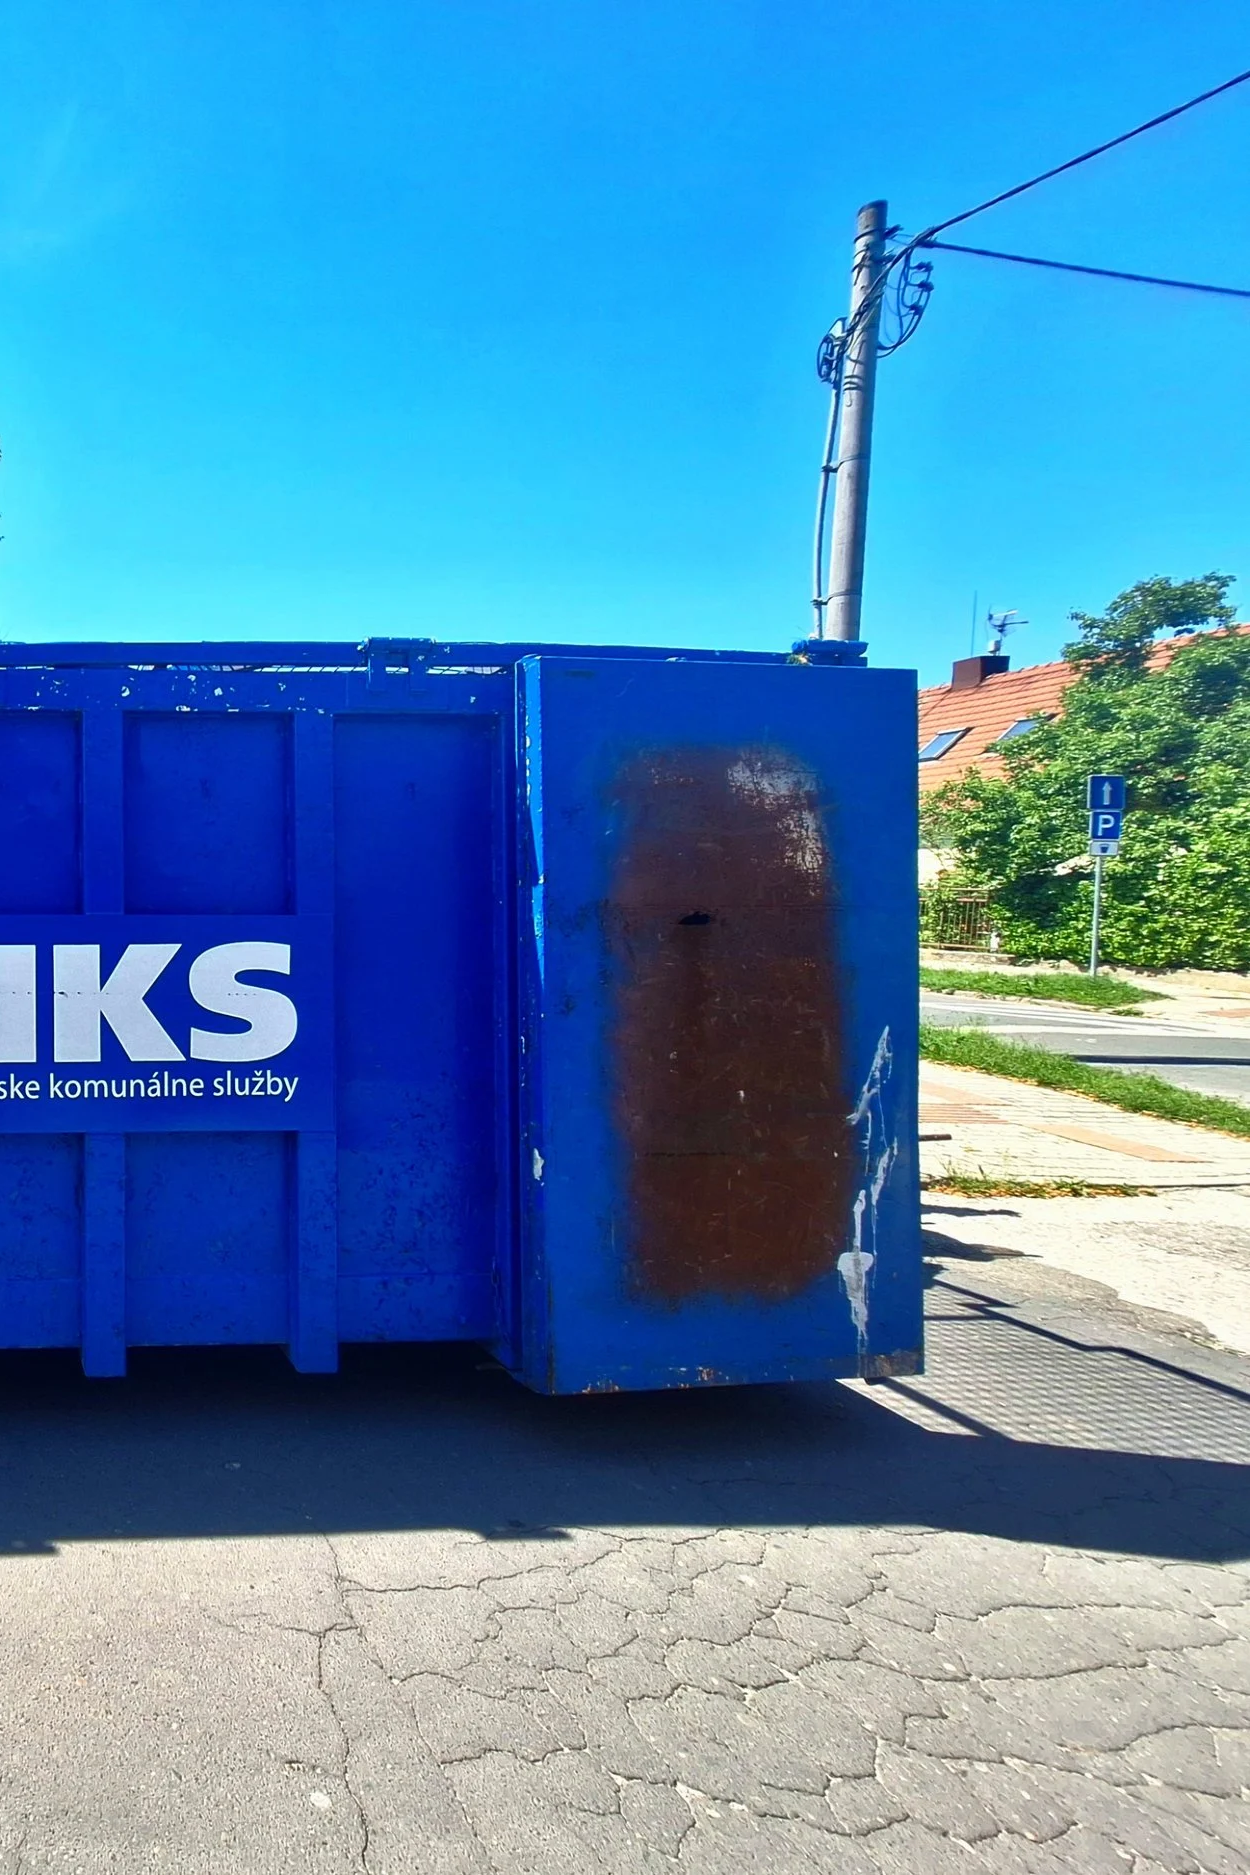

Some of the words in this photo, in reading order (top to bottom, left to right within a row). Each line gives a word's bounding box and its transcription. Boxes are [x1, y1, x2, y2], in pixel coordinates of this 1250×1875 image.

[1097, 814, 1115, 836] P
[49, 1070, 205, 1099] komunálne
[213, 1069, 299, 1103] služby
